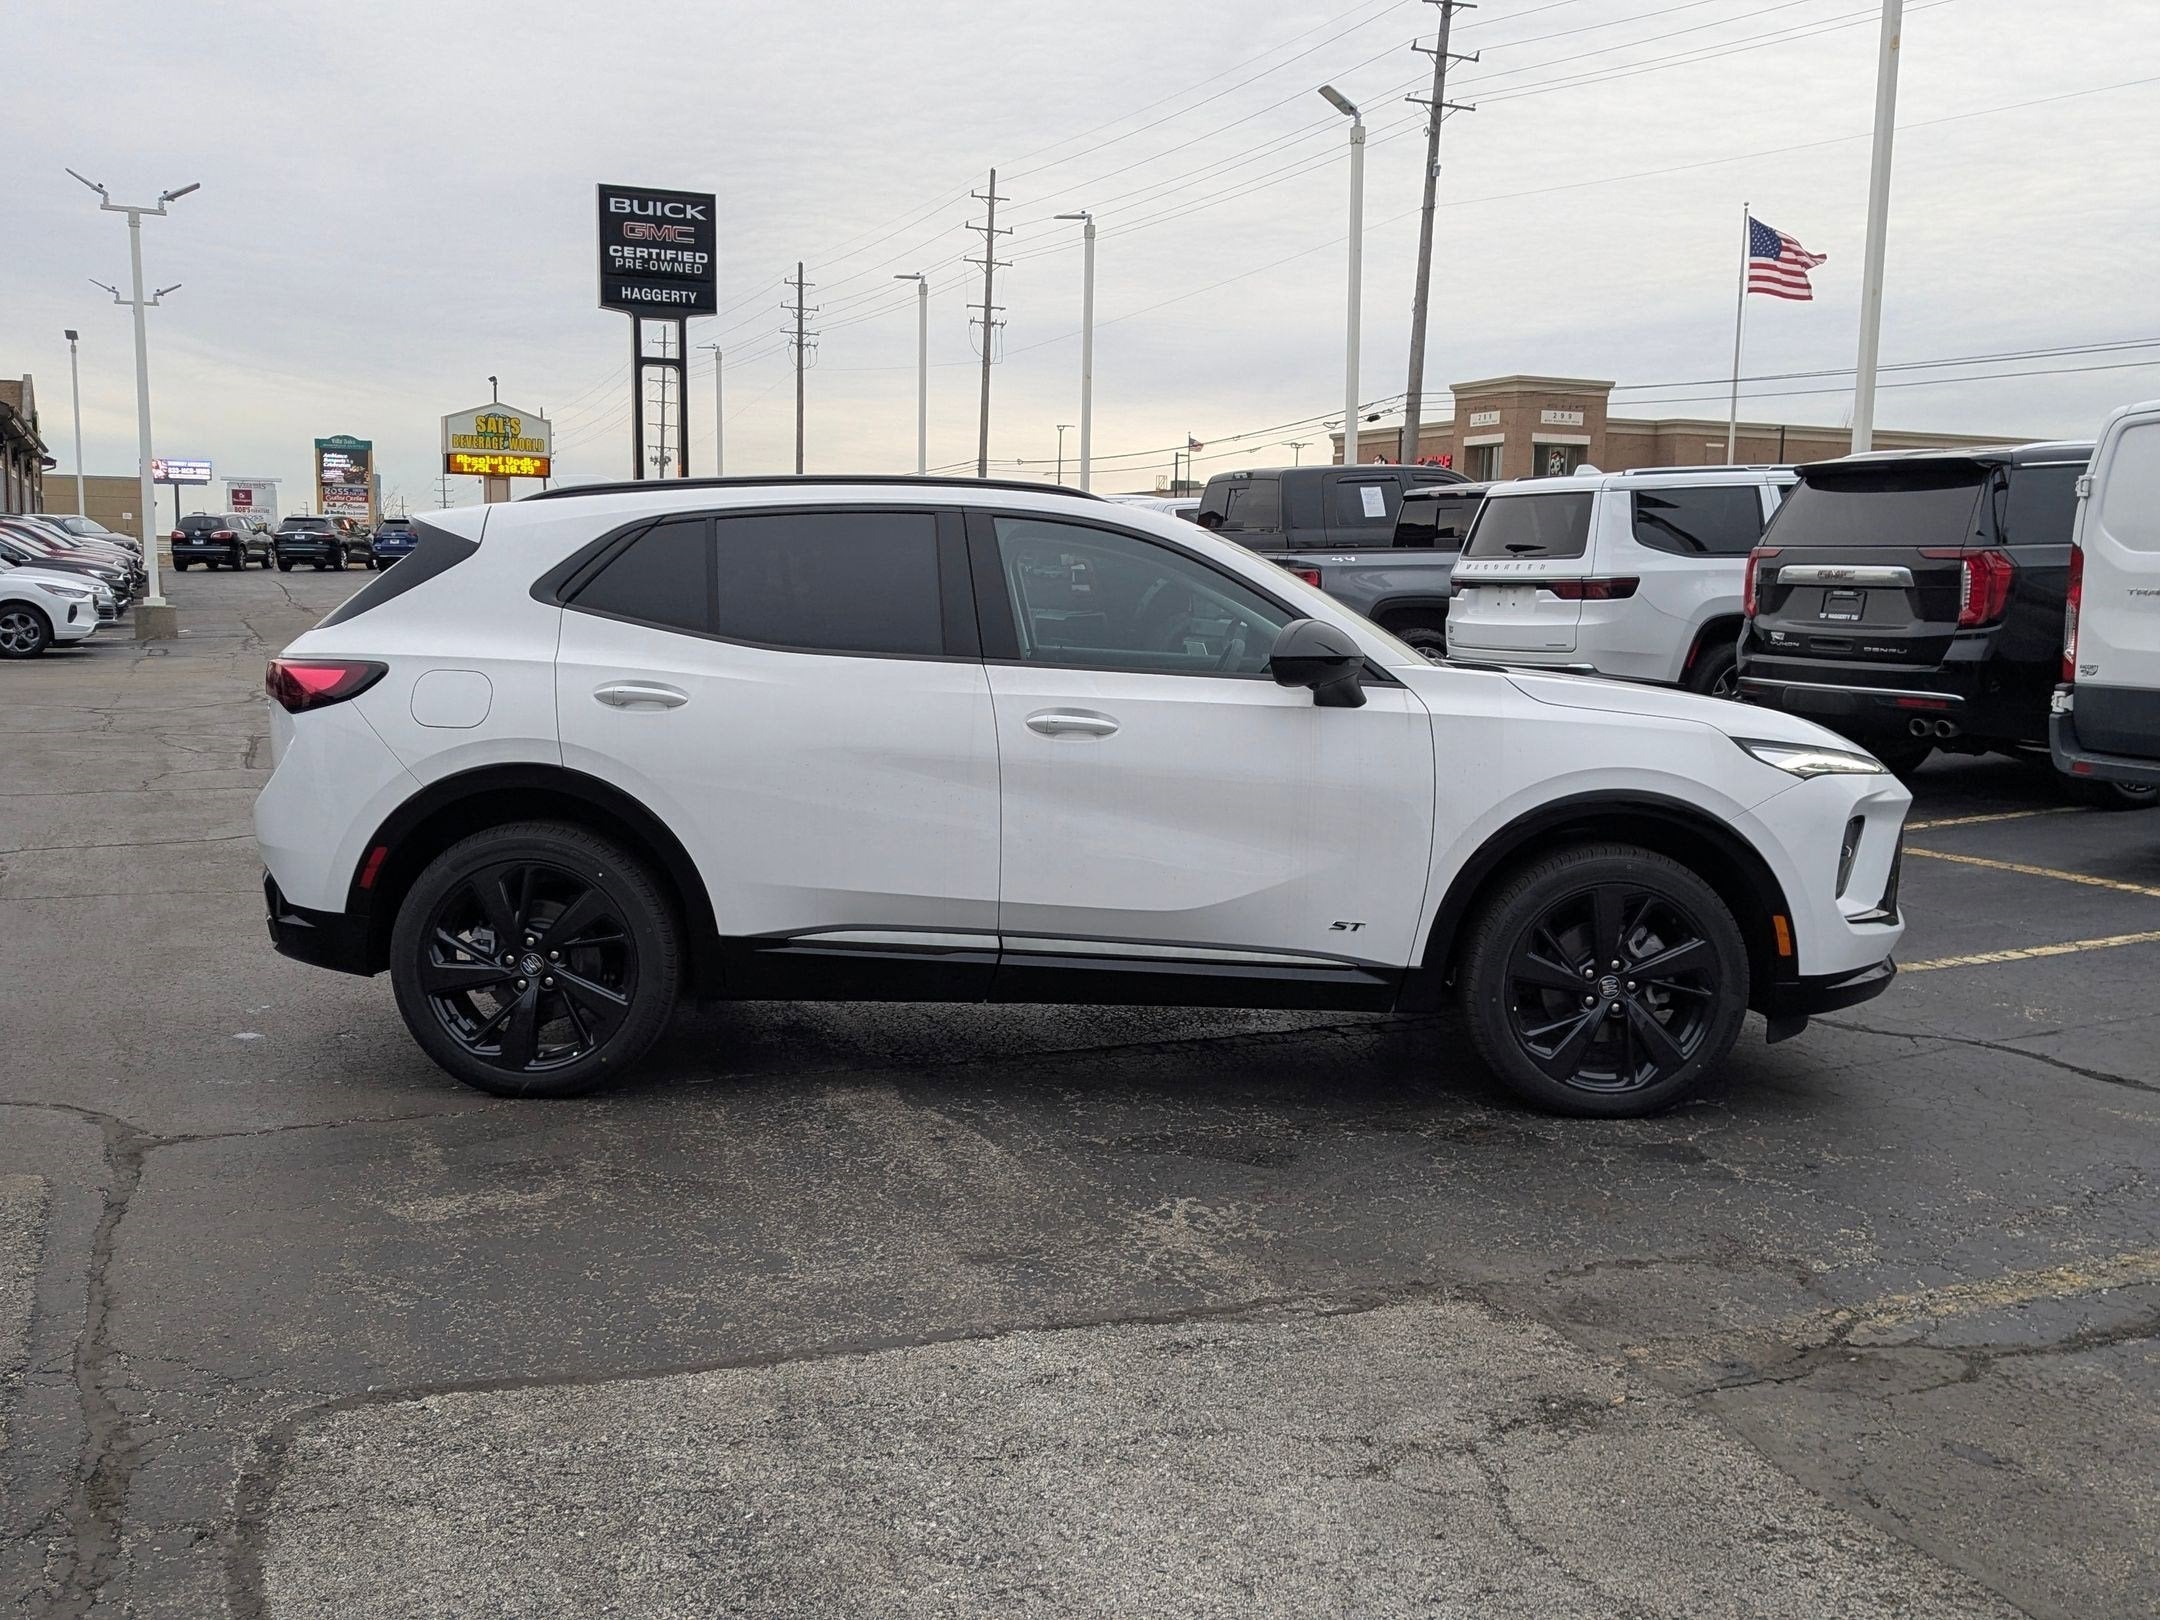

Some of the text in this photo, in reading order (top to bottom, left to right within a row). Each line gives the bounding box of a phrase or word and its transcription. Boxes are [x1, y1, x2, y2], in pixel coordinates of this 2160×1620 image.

[609, 197, 708, 220] BUICK
[623, 221, 695, 244] GMC
[609, 245, 709, 264] CERTIFIED
[615, 257, 703, 274] PRE-OWNED
[621, 286, 698, 304] HAGGERTY
[475, 415, 521, 436] SAL'S
[452, 433, 545, 452] BEVERAGE WORLD
[456, 454, 541, 467] Absolut Vodka
[463, 463, 535, 475] 1.75L $18.99
[325, 487, 349, 496] ROSS
[1864, 646, 1908, 654] DENALI
[1328, 920, 1367, 932] ST
